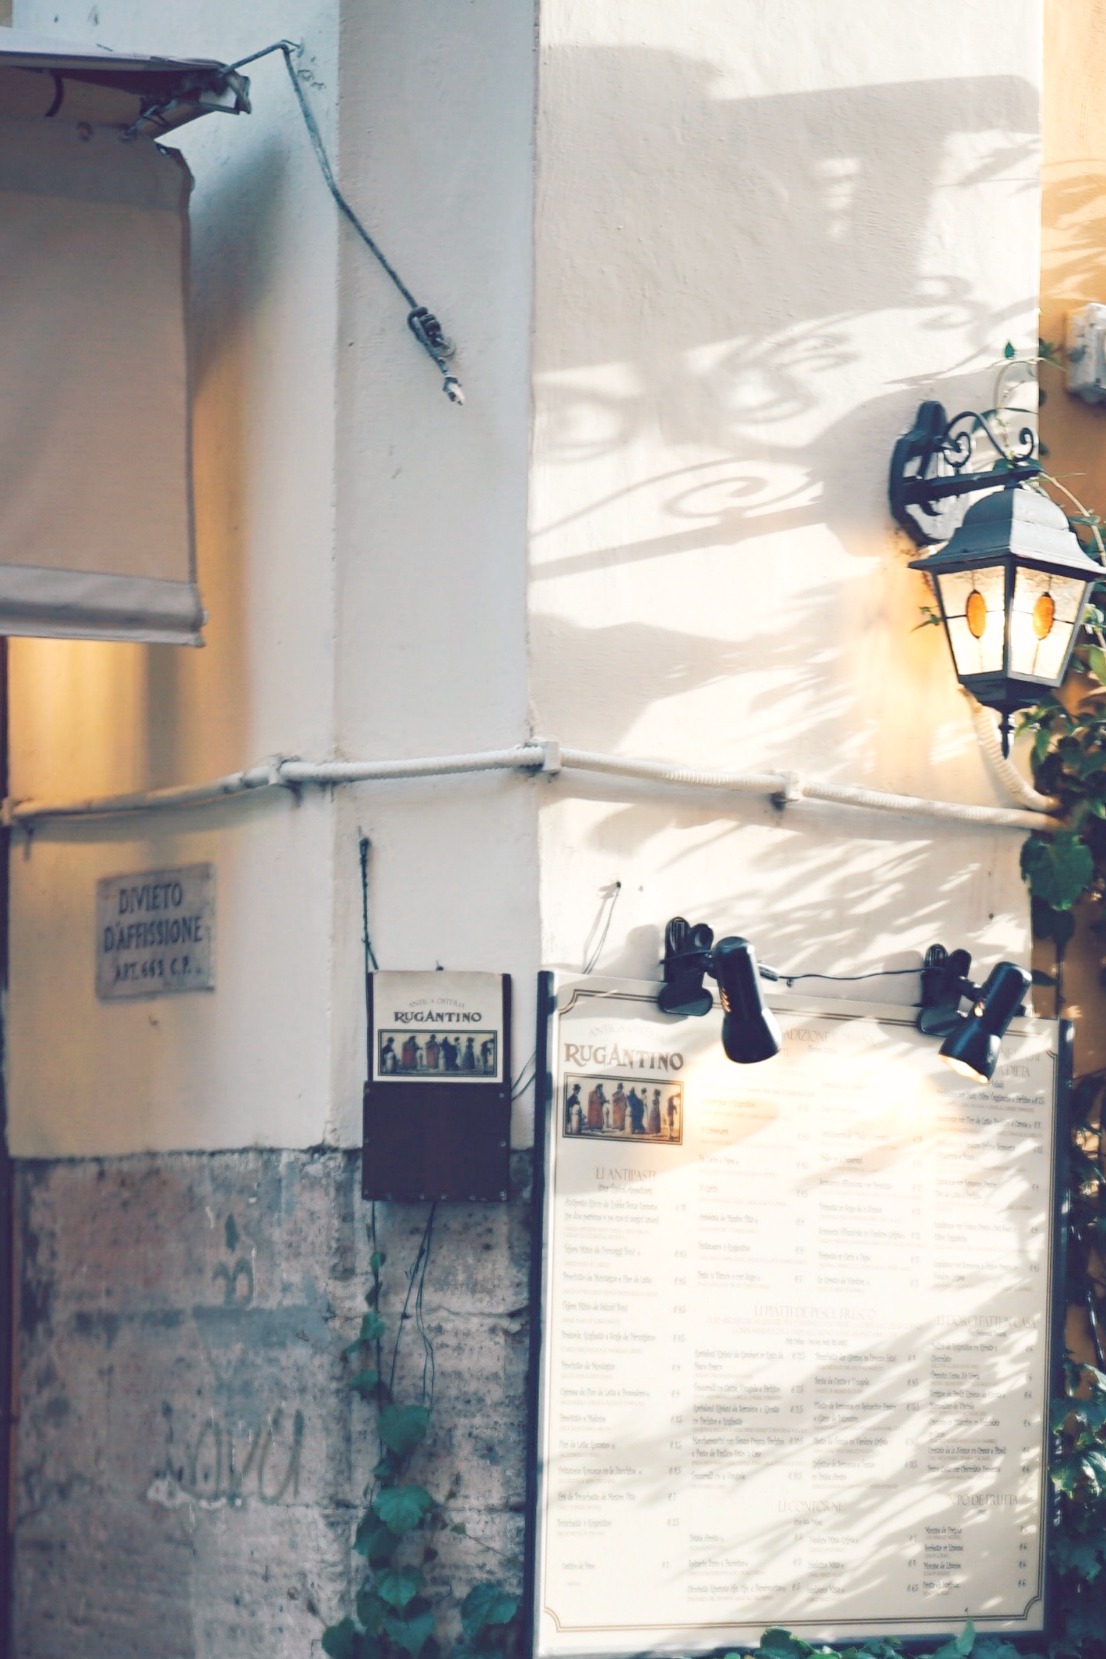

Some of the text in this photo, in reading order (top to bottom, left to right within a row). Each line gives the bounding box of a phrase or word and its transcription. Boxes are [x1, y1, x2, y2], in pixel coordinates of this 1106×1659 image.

[118, 881, 184, 915] DIVIETO
[393, 1009, 483, 1024] RUGANTINO
[563, 1040, 685, 1072] RUGANTINO
